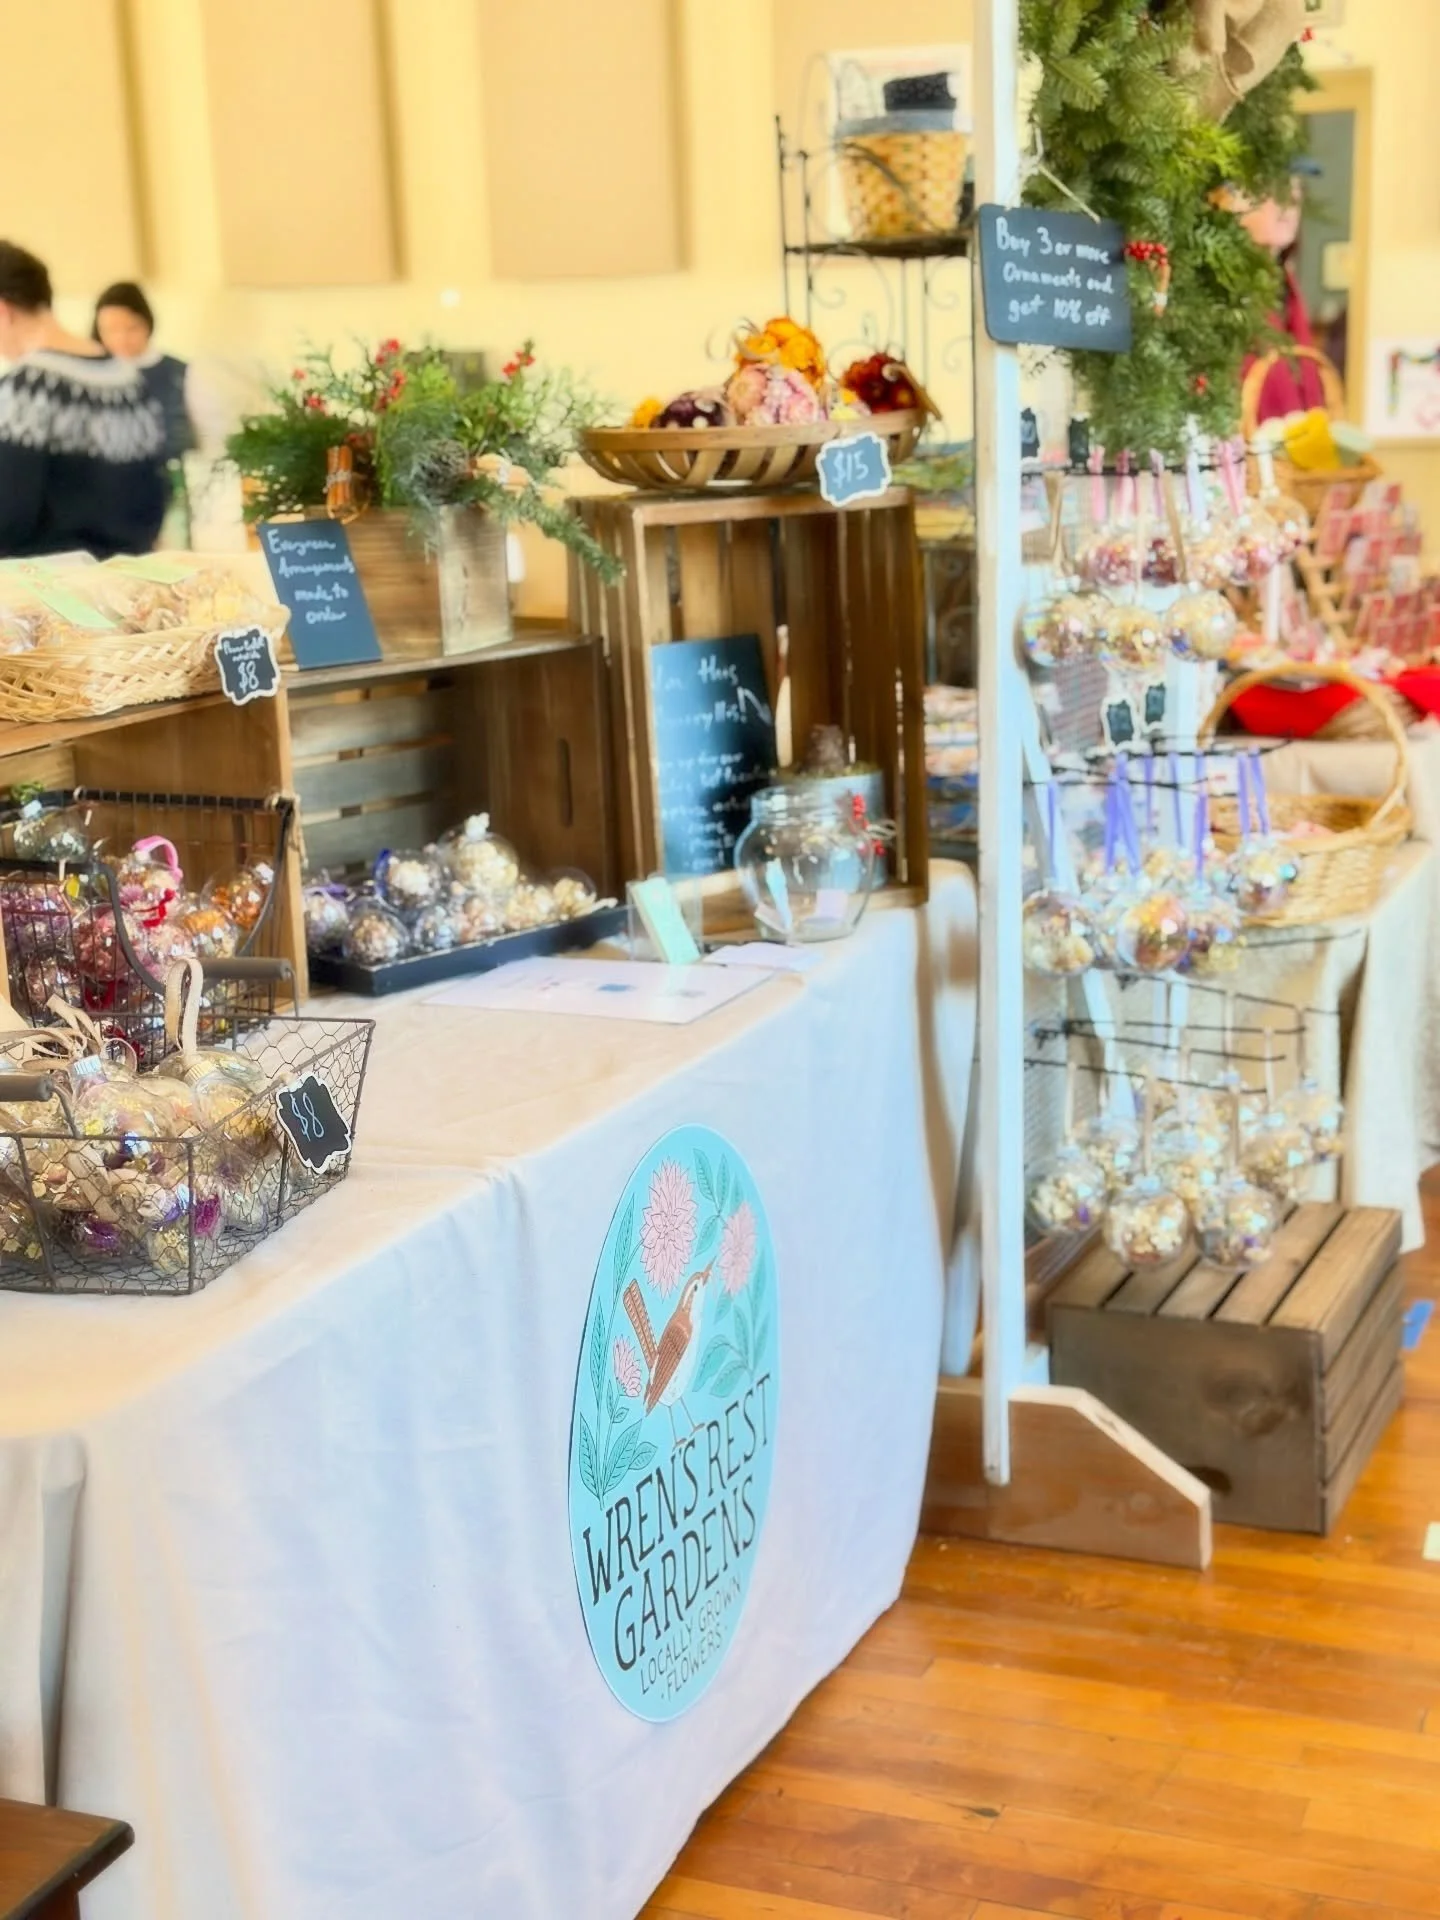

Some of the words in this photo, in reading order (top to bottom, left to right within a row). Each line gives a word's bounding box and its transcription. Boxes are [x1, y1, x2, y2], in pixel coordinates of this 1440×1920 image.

[995, 215, 1031, 258] Buy
[1036, 226, 1053, 255] 3
[1054, 241, 1073, 257] or
[1075, 243, 1110, 265] more
[1002, 260, 1082, 289] Ornaments
[1086, 273, 1115, 295] and
[1007, 293, 1045, 324] get
[1053, 297, 1082, 324] 10%
[1084, 304, 1112, 327] off
[832, 449, 869, 490] $15
[237, 660, 259, 694] $8
[289, 1092, 325, 1142] $8
[582, 1440, 699, 1607] WREN'S
[706, 1373, 772, 1497] REST
[613, 1474, 757, 1671] GARDENS
[640, 1616, 694, 1695] LOCALLY
[698, 1573, 742, 1632] GROWN
[666, 1621, 722, 1701] FLOWERS
